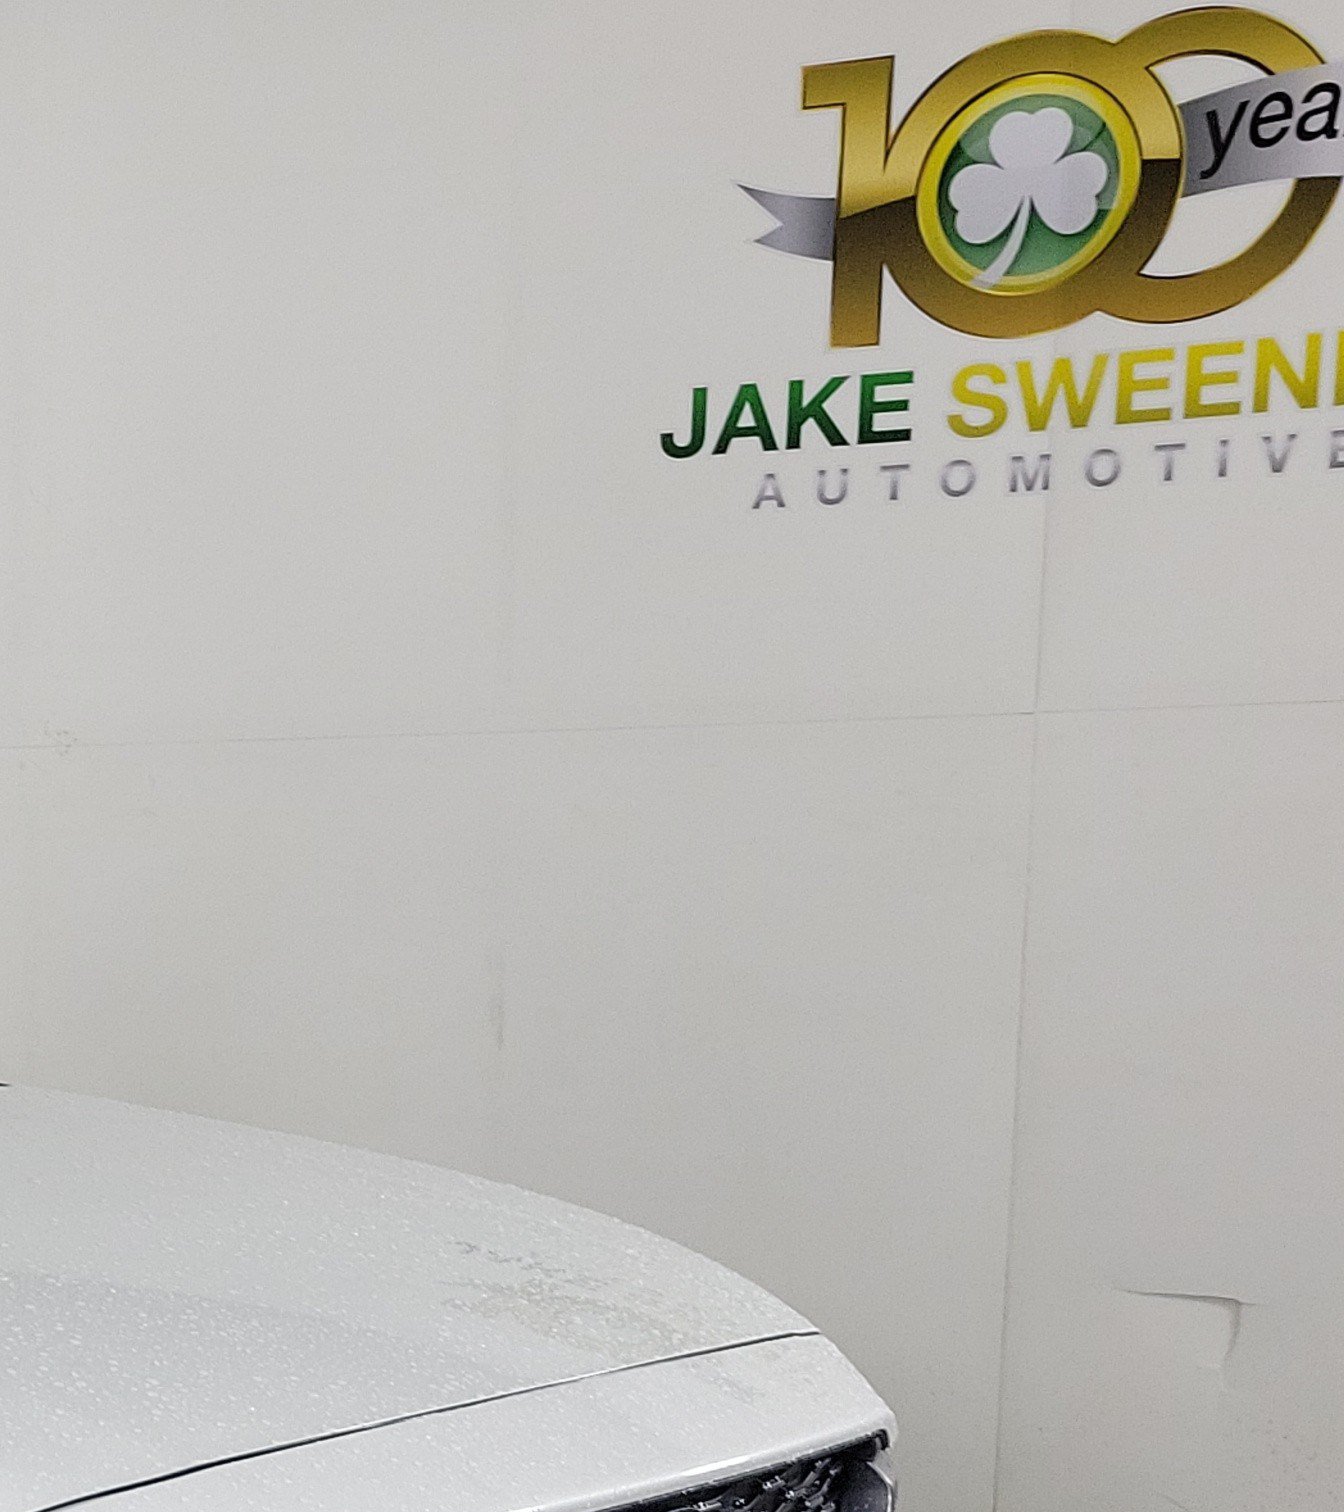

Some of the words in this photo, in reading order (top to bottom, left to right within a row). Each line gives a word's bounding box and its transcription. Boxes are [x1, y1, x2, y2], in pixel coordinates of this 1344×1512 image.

[800, 5, 1343, 349] 100
[1199, 80, 1344, 180] yea
[659, 369, 914, 460] JAKE
[945, 328, 1344, 440] SWEEN
